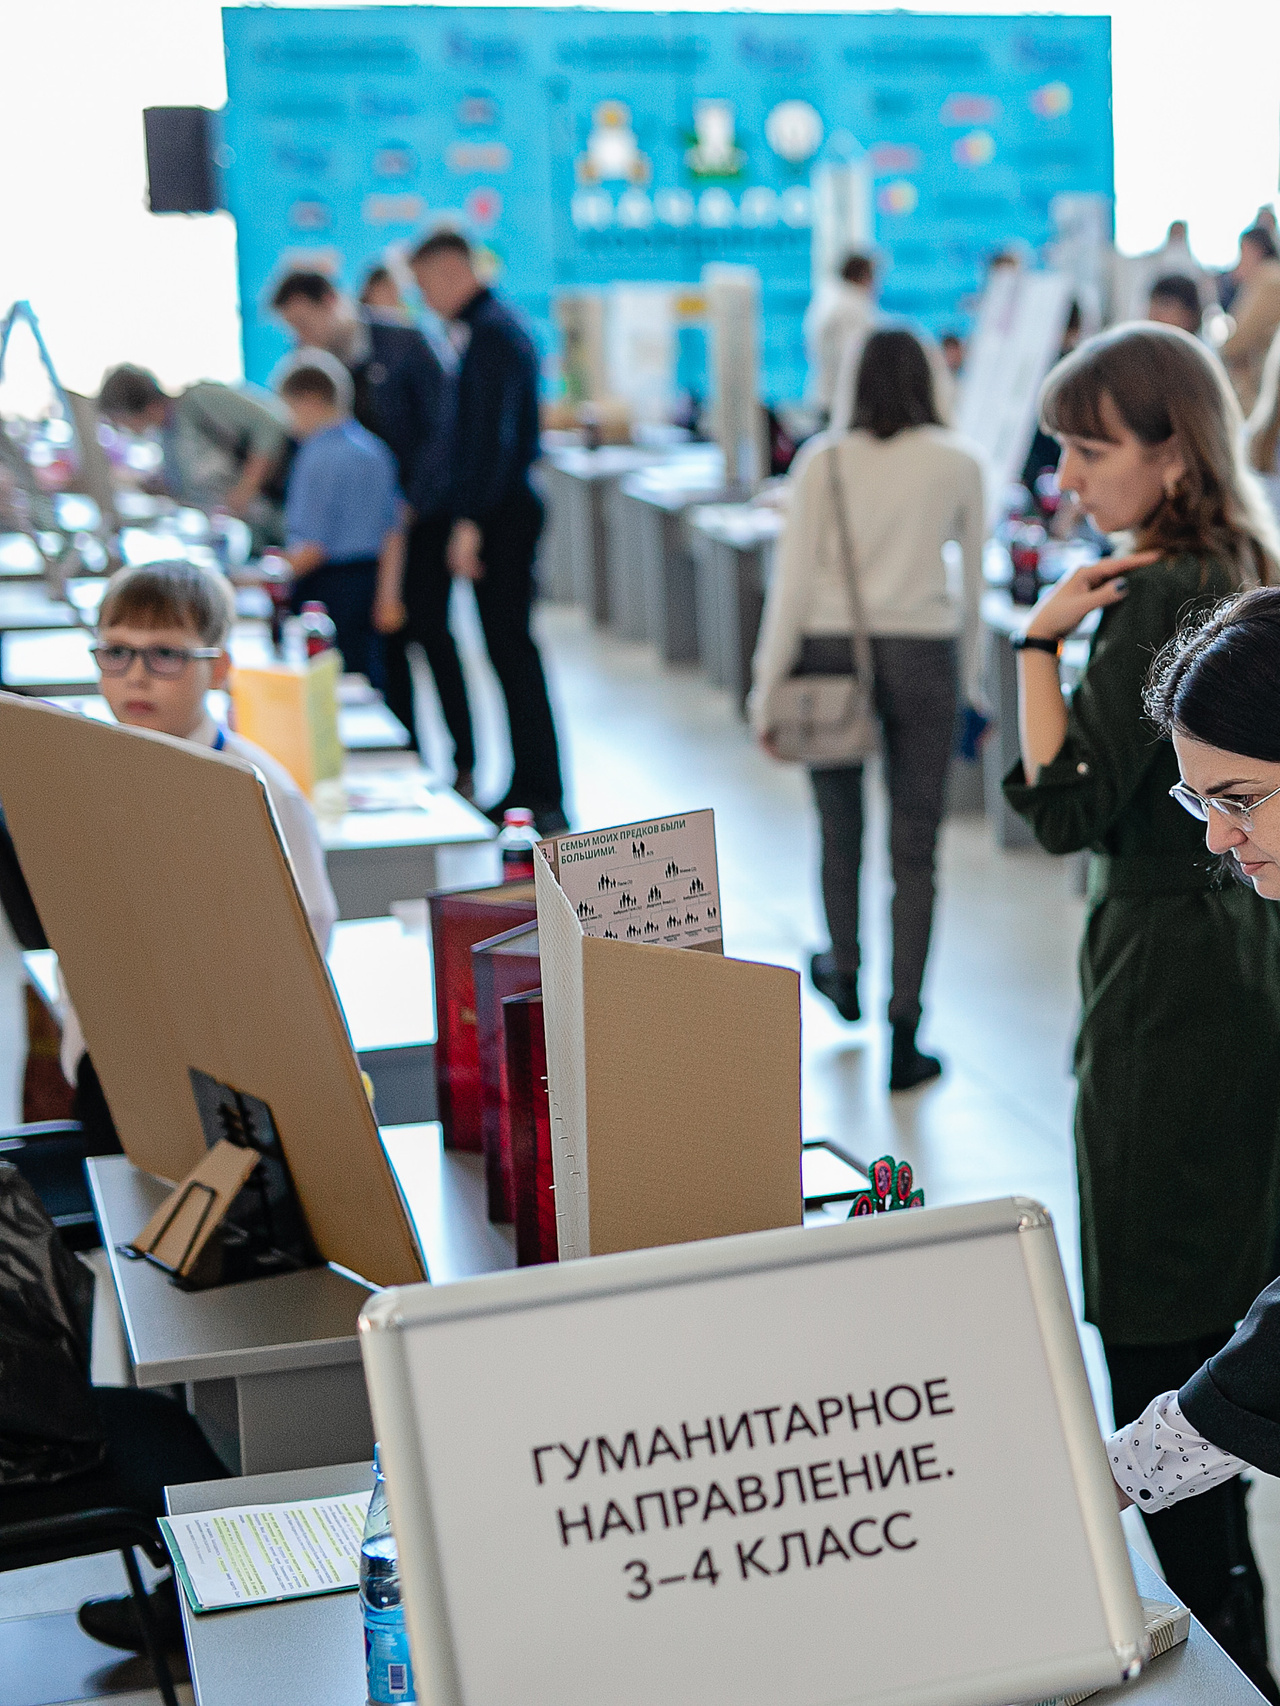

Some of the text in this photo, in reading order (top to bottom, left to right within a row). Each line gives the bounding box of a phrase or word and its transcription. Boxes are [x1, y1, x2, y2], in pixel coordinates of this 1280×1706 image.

[560, 819, 686, 852] СЕМЬИ МОИХ ПРЕДКОВ БЫЛИ
[560, 845, 617, 864] БОЛЬШИМИ.
[532, 1377, 954, 1485] ГУМАНИТАРНОЕ
[557, 1442, 955, 1547] НАПРАВЛЕНИЕ.
[735, 1511, 919, 1580] КЛАСС
